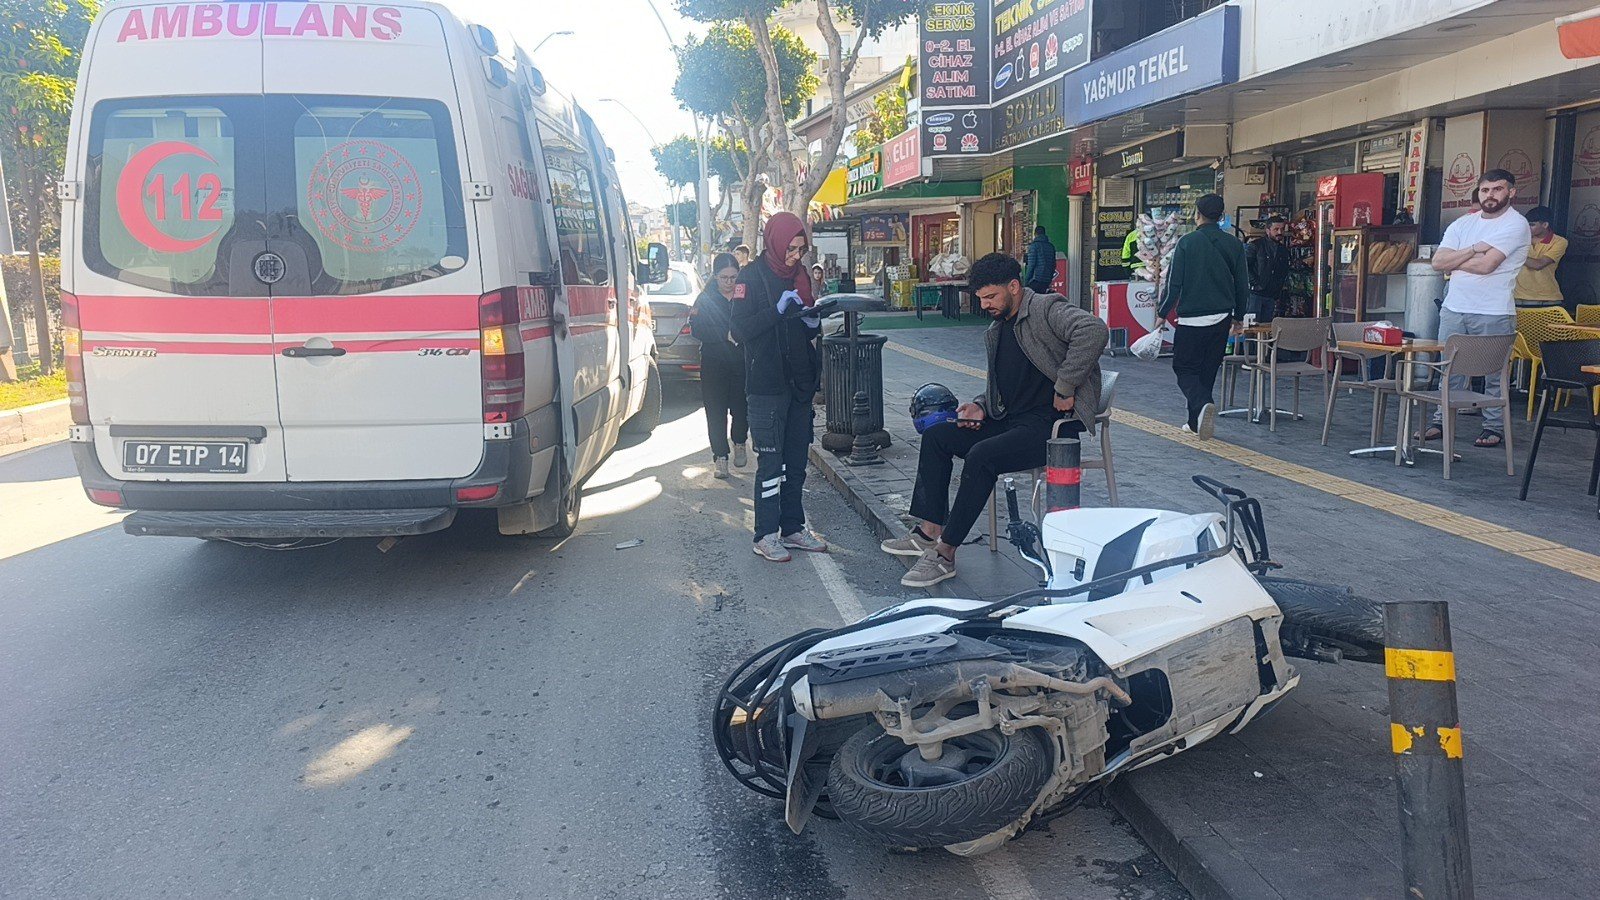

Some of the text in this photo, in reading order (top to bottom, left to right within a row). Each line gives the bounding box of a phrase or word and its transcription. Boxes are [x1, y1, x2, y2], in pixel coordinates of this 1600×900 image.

[117, 3, 403, 42] AMBULANS
[956, 38, 976, 52] EL
[928, 54, 973, 68] CİHAZ
[932, 70, 970, 83] ALIM
[1083, 45, 1189, 105] YAĞMUR TEKEL
[926, 85, 976, 99] SATIMI
[1005, 84, 1057, 129] SOYLU
[146, 173, 224, 222] 112
[524, 288, 549, 319] AMB
[418, 348, 443, 356] 316
[135, 444, 241, 466] 07 ETP 14
